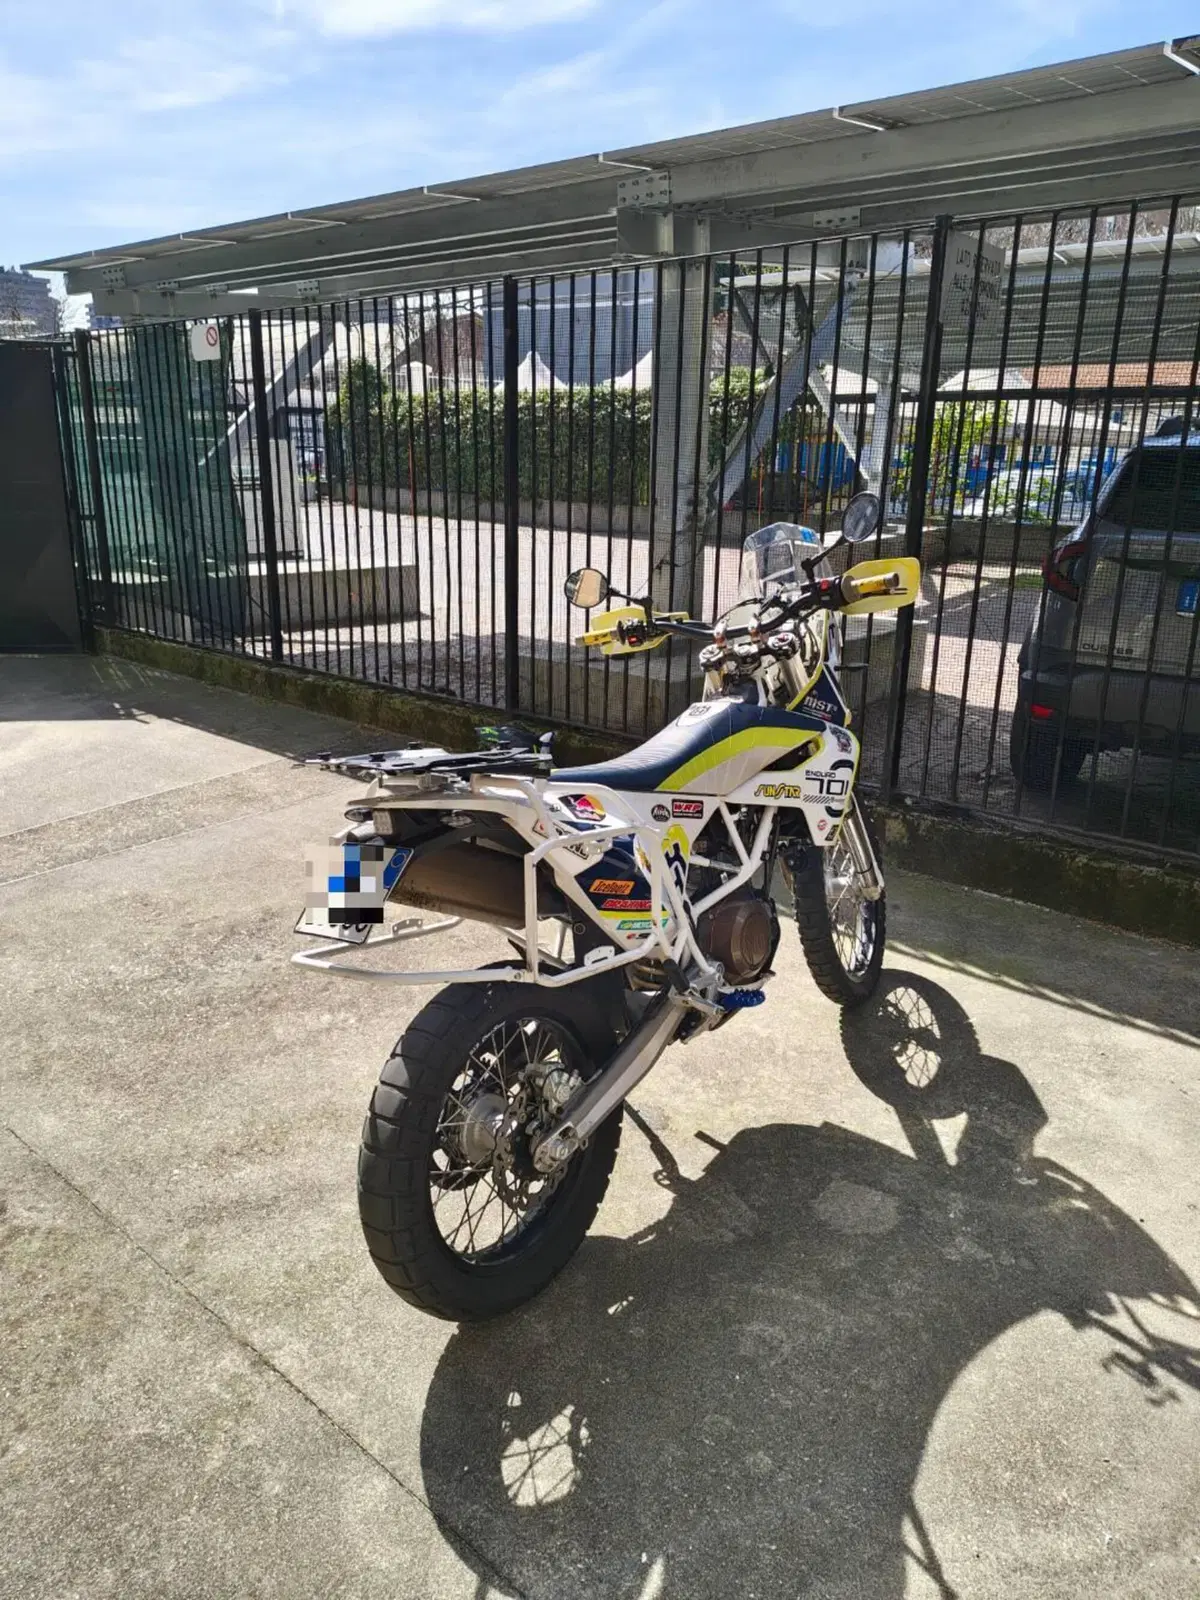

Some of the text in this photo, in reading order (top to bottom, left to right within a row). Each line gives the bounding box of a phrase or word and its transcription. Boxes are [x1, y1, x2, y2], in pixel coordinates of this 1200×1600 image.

[1082, 642, 1134, 655] DUSER
[805, 769, 836, 779] ENDURO
[673, 801, 703, 813] WRP
